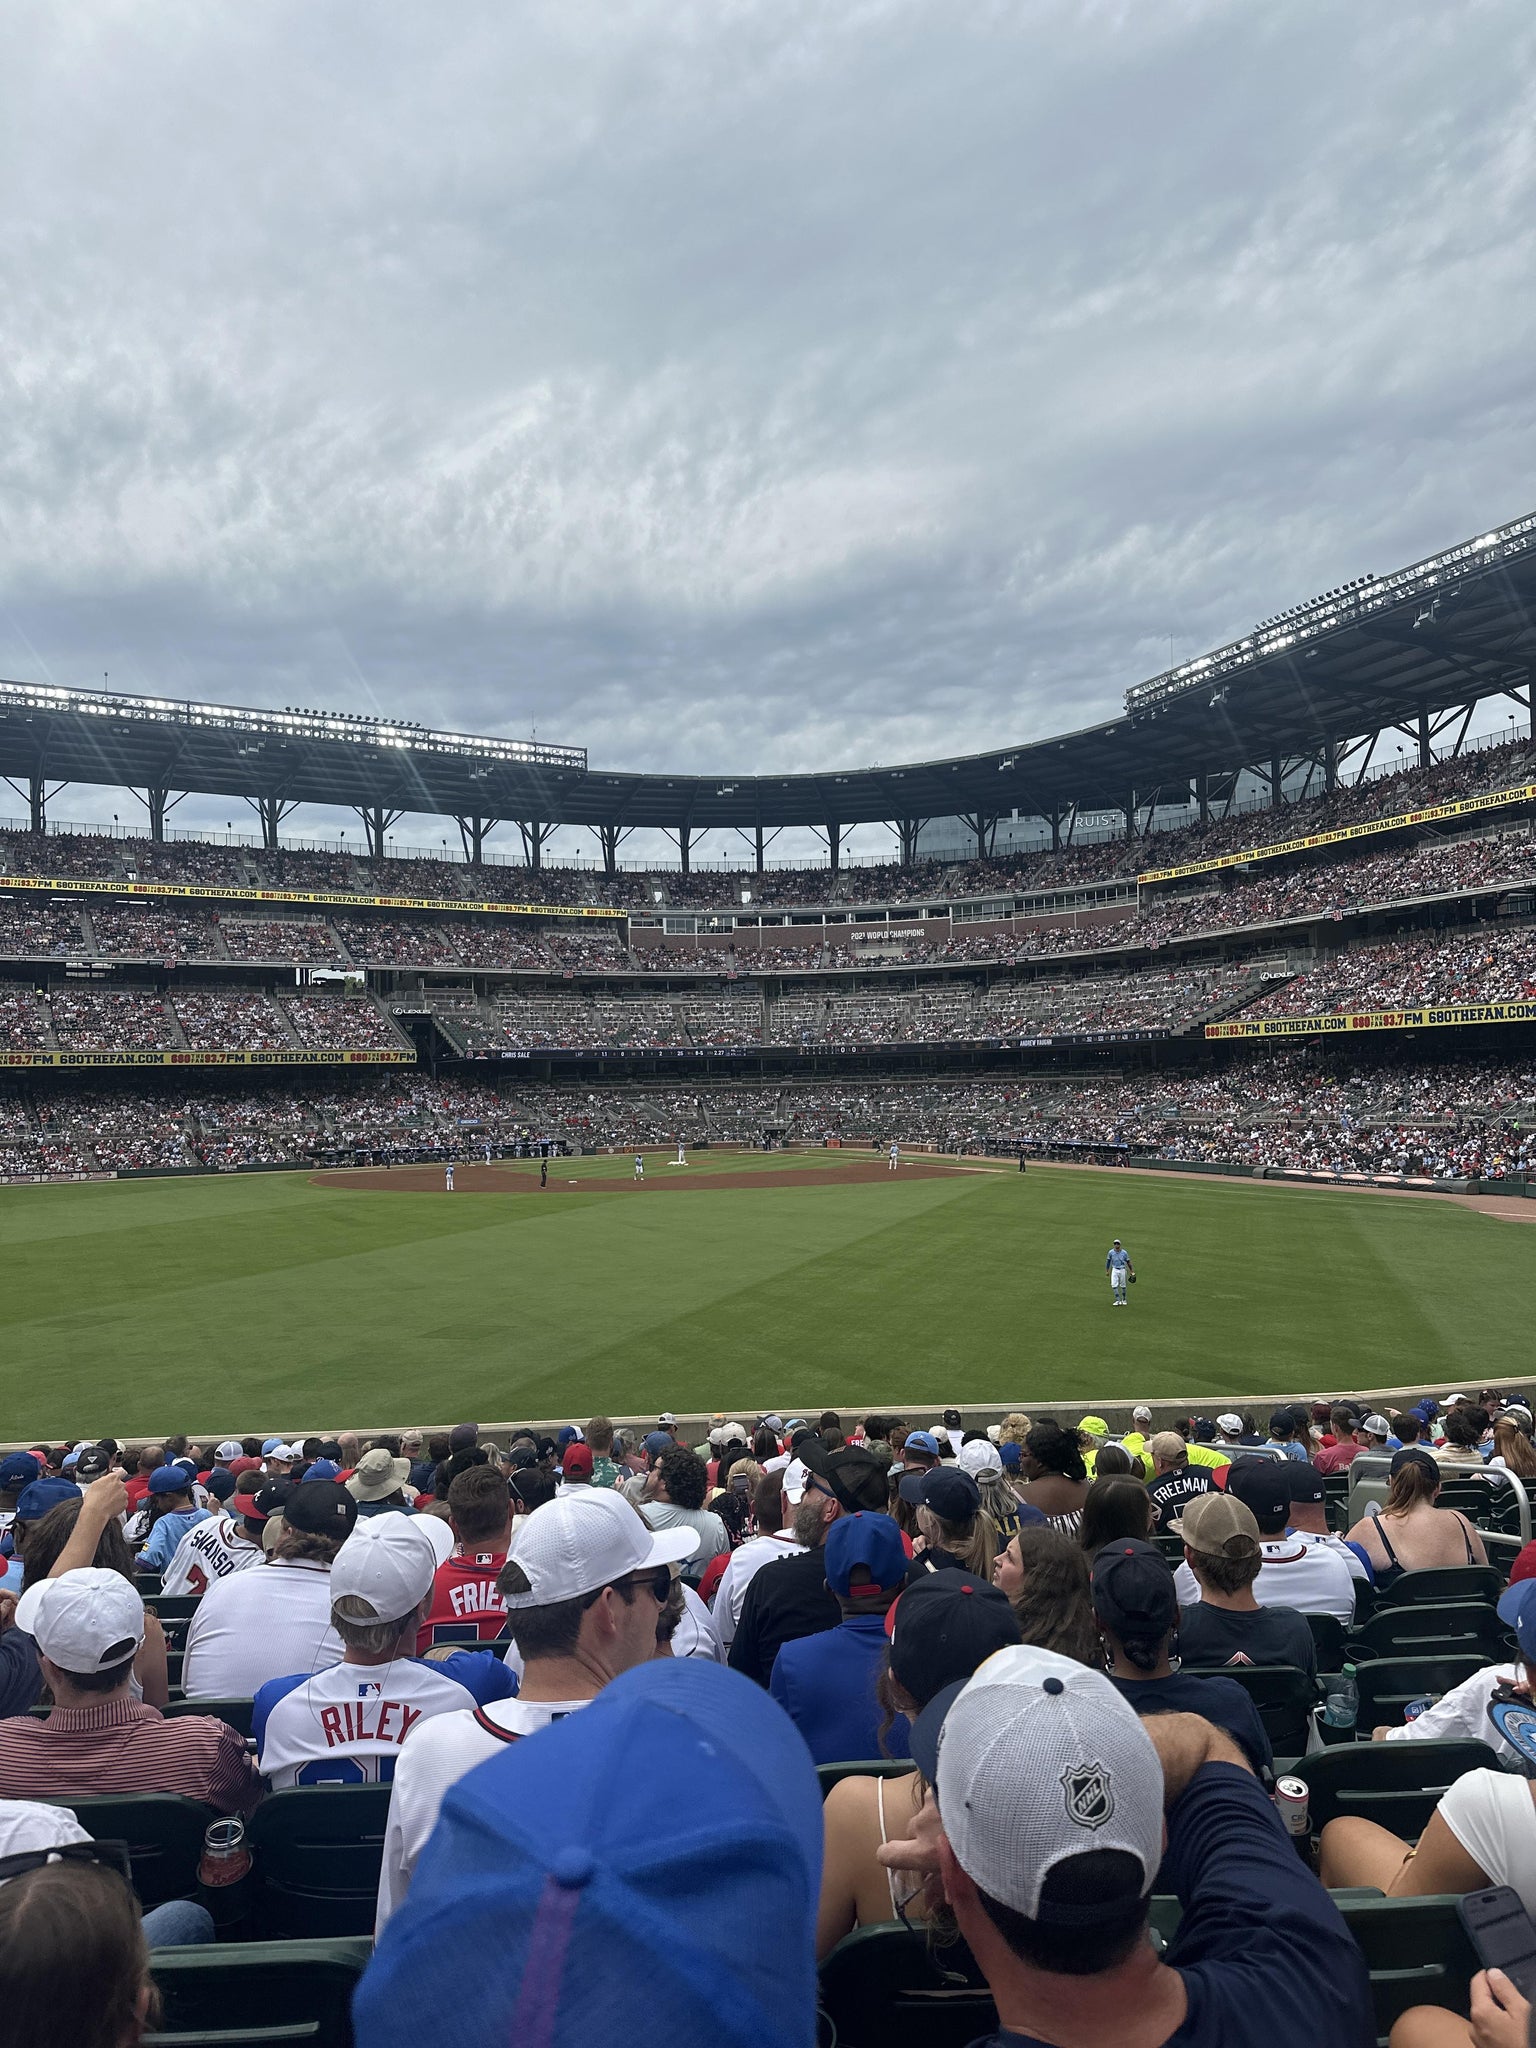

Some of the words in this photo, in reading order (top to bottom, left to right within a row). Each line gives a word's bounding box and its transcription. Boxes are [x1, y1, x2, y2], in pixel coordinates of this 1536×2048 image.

[1065, 814, 1118, 828] TRUIST
[1350, 816, 1407, 836] 680THEFAN.COM
[1460, 788, 1527, 812] 680THEFAN.COM
[56, 882, 129, 892] 680THEFAN.COM
[189, 888, 257, 898] 680THEFAN.COM
[313, 894, 376, 904] 680THEFAN.COM
[867, 931, 888, 940] WORLD
[890, 928, 925, 938] CHAMPIONS
[1264, 1018, 1347, 1034] 680THEFAN.COM
[1383, 1012, 1423, 1026] 93.7FM
[1428, 1006, 1536, 1024] 680THEFAN.COM
[8, 1054, 54, 1064] 93.7FM
[60, 1054, 164, 1064] 680THEFAN.COM
[204, 1054, 245, 1064] 93.7FM
[250, 1053, 344, 1062] 680THEFAN.COM
[380, 1053, 416, 1062] 93.7FM
[1153, 1477, 1208, 1504] FREEMAN
[320, 1700, 422, 1748] RILEY
[1077, 1782, 1101, 1814] NHL
